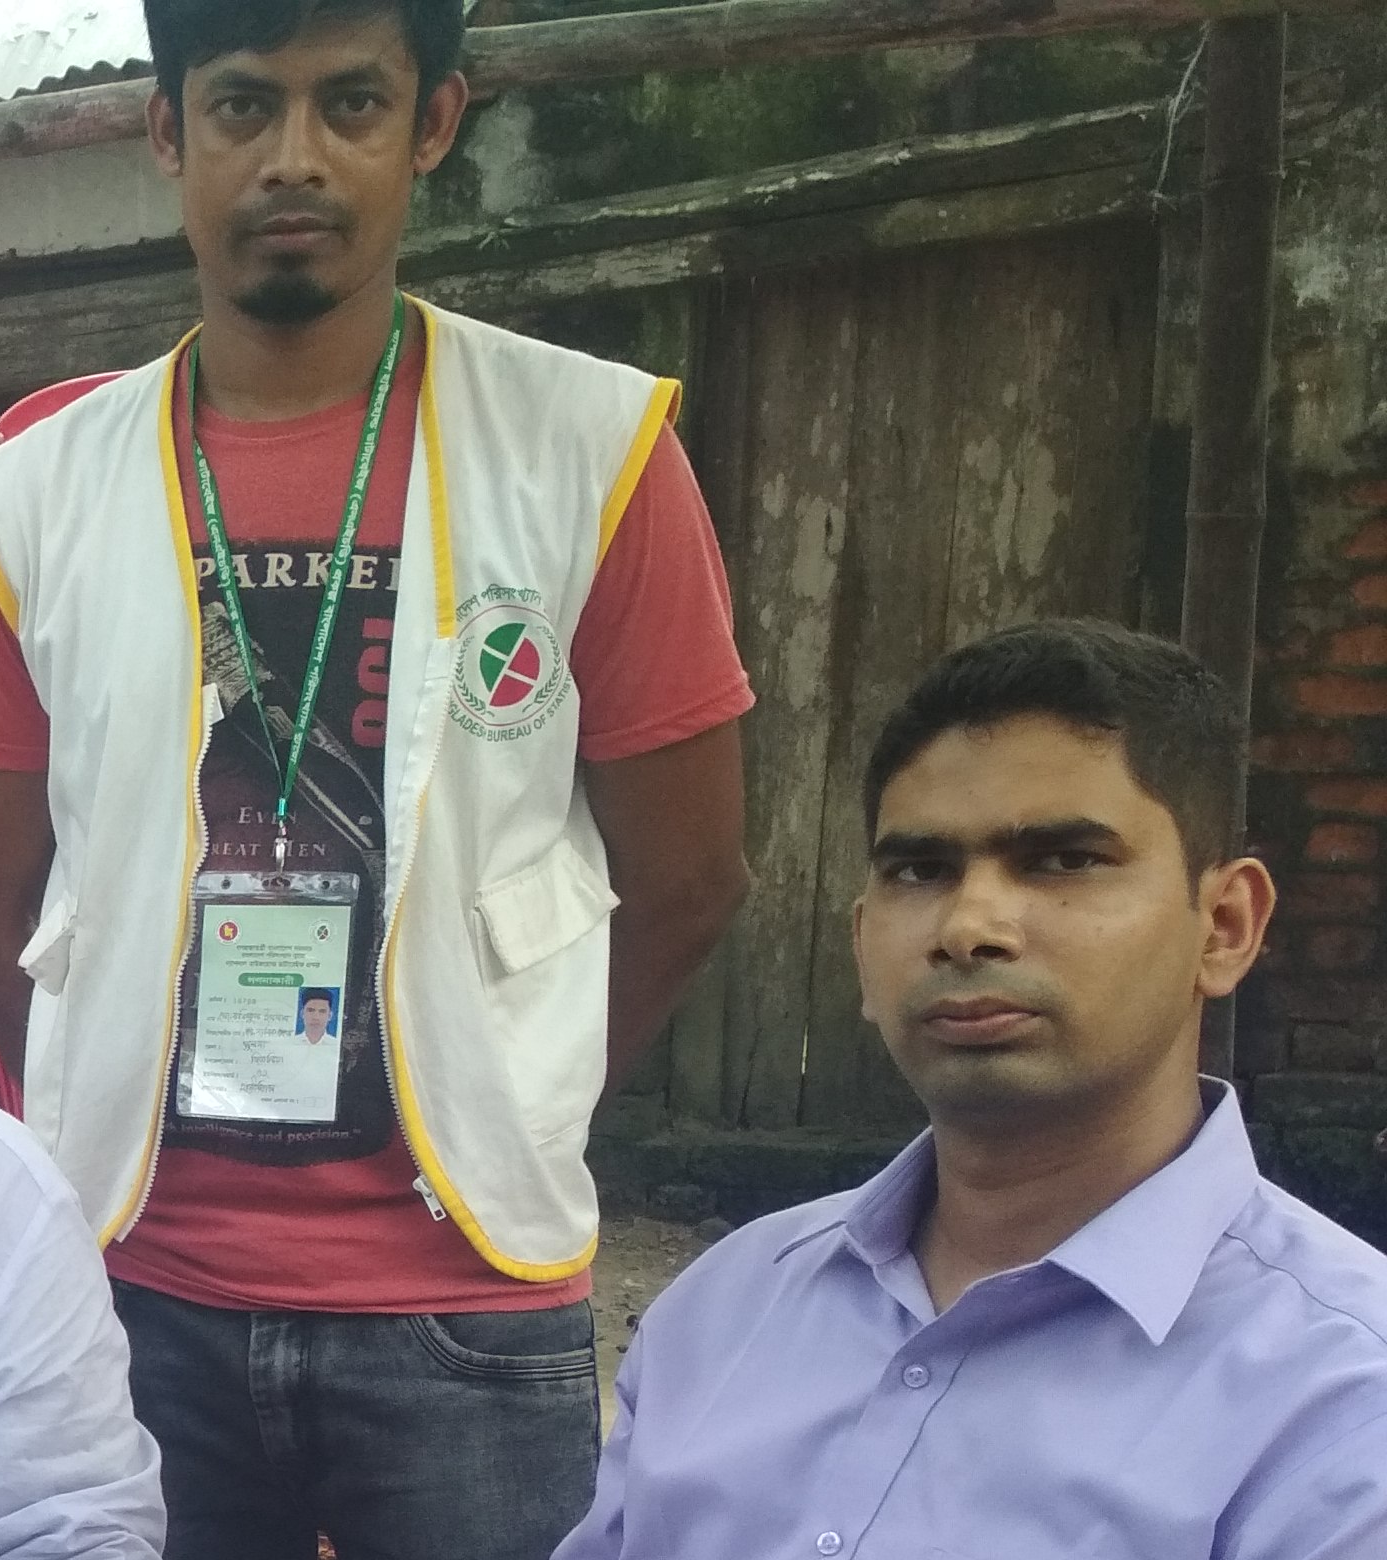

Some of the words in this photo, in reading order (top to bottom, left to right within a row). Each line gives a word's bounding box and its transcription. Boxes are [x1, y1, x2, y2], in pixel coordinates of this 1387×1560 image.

[487, 725, 532, 742] BUREAU
[533, 713, 546, 730] OF
[210, 843, 261, 857] REAT
